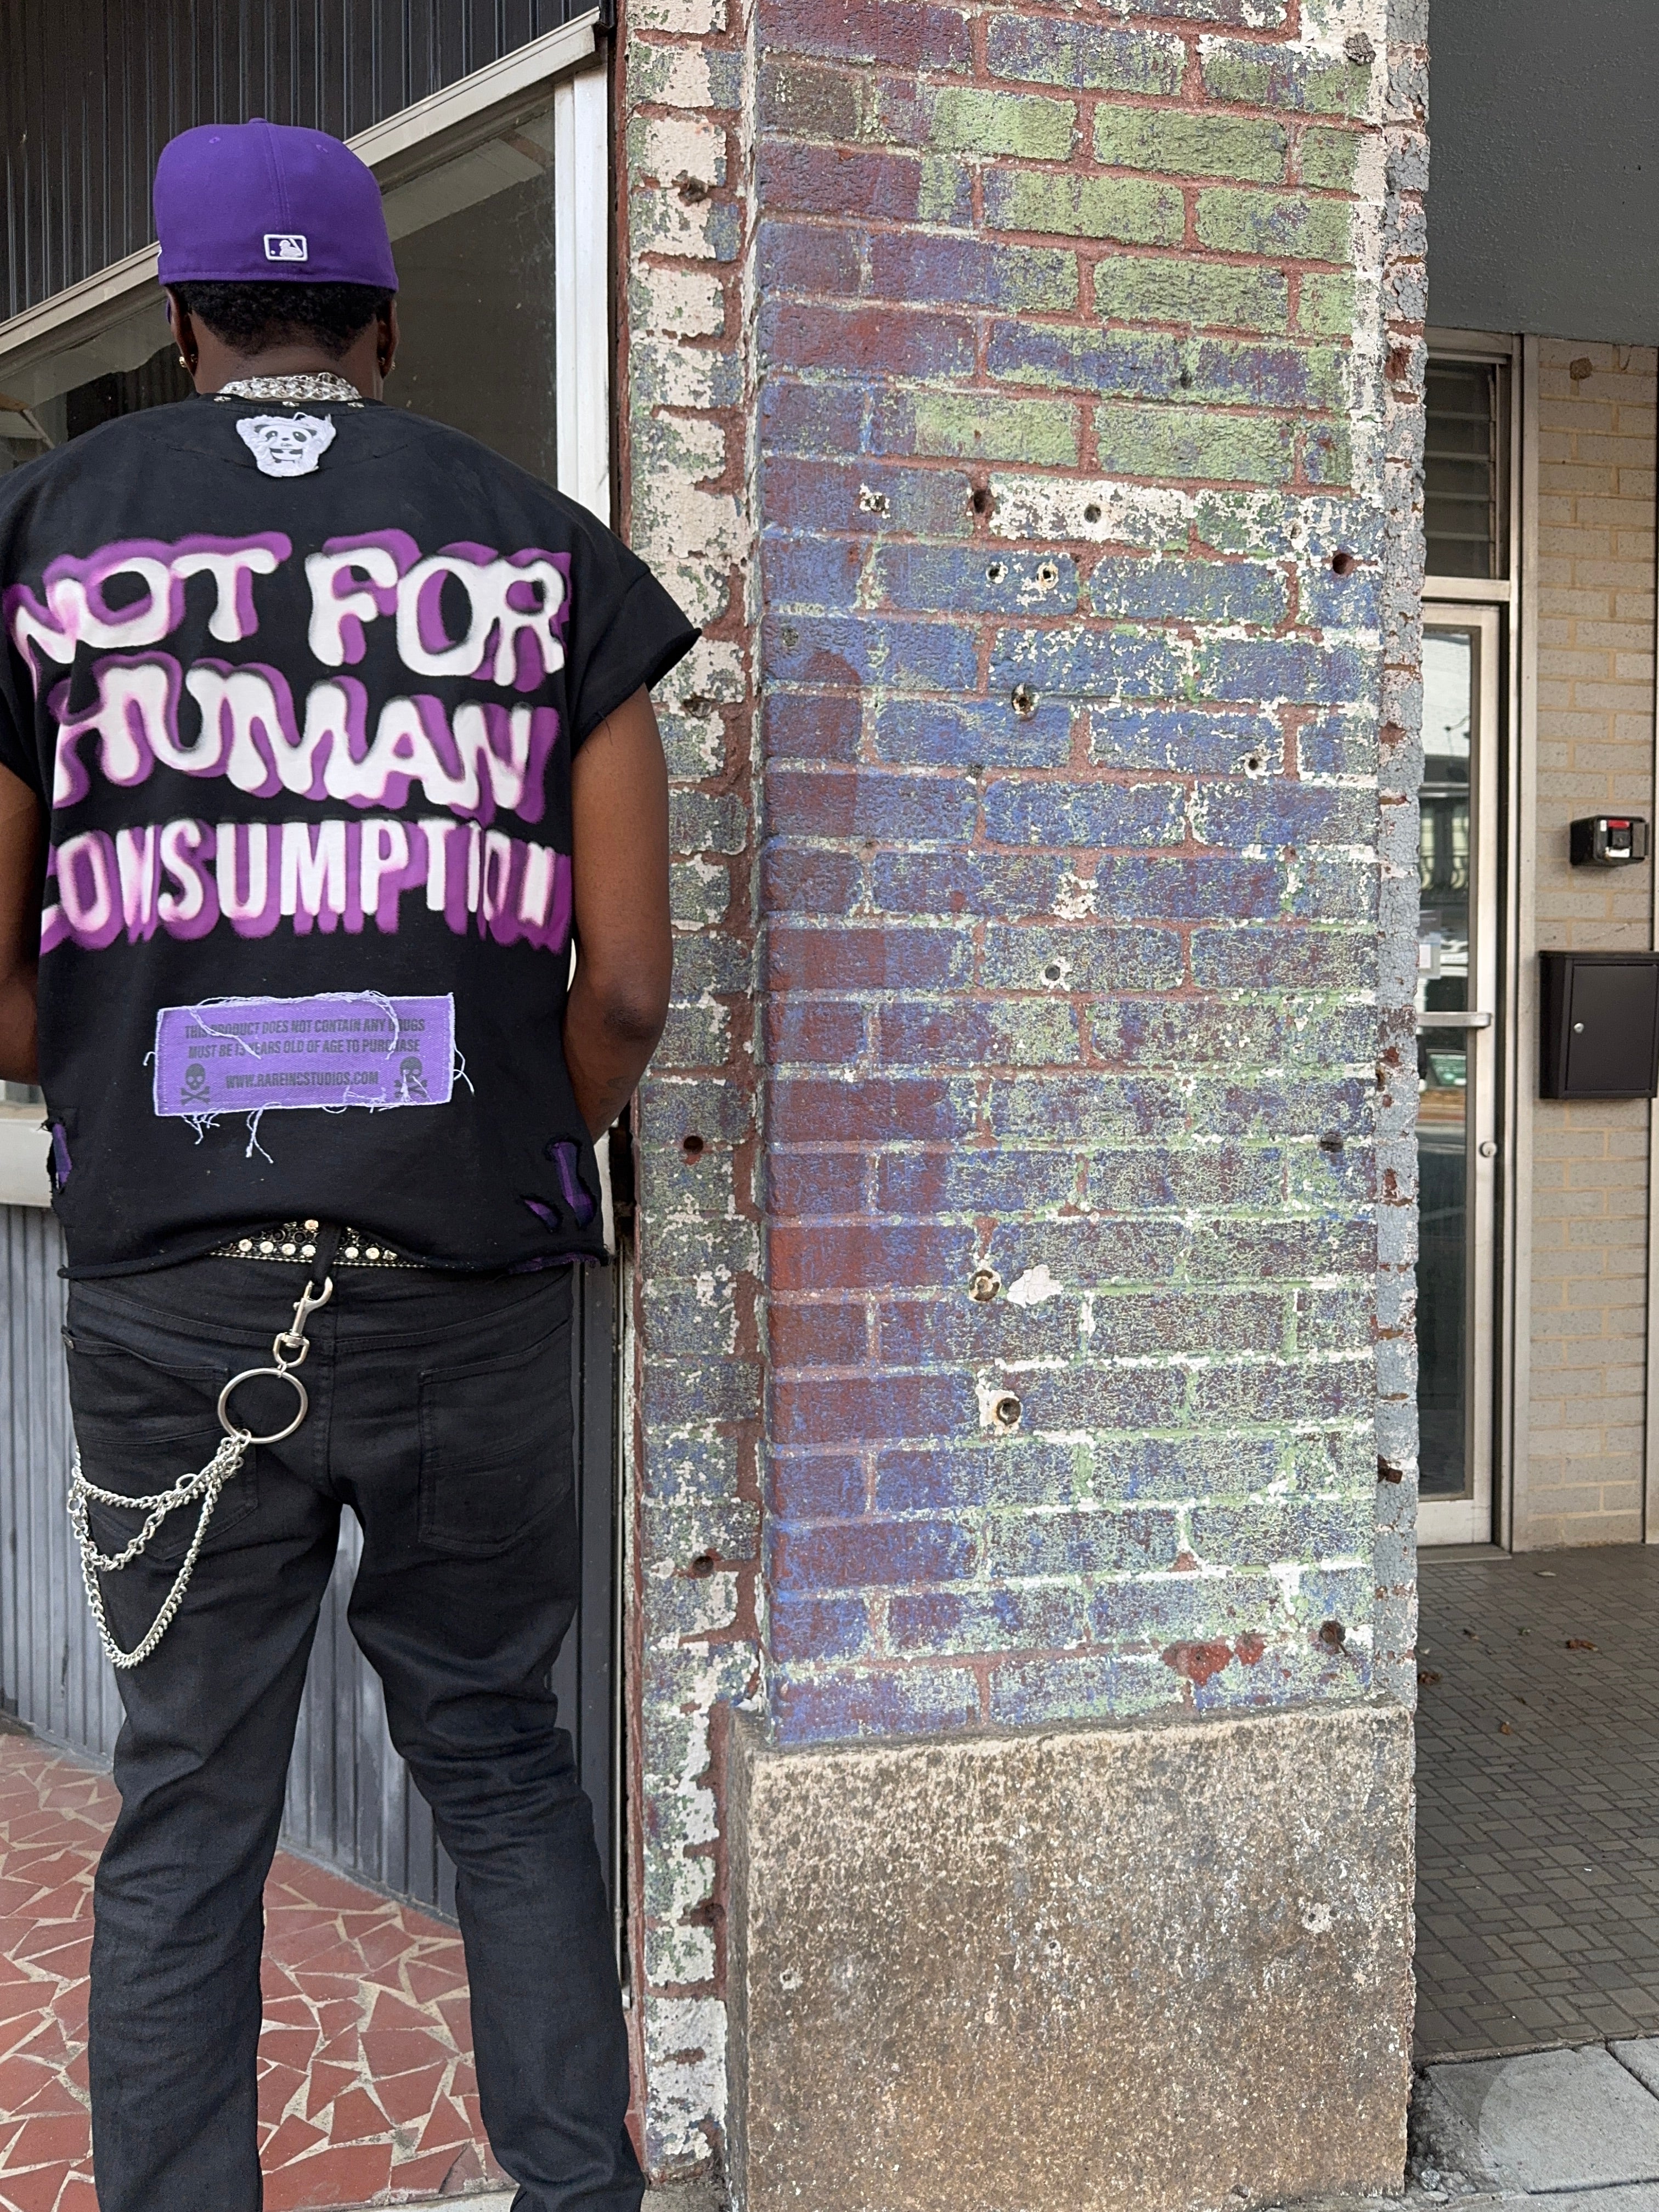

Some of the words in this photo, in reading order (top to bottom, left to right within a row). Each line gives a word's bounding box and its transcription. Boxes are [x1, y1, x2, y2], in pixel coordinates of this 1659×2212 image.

[5, 533, 290, 699] NOT
[305, 531, 571, 690] FOR
[52, 655, 551, 817] HUMAN
[42, 819, 569, 952] ONSUMPTION
[185, 1025, 207, 1039] THIS
[211, 1022, 260, 1037] PRODUCT
[263, 1020, 289, 1034] DOES
[292, 1019, 312, 1033] NOT
[315, 1019, 360, 1032] CONTAIN
[364, 1018, 385, 1031] ANY
[189, 1045, 217, 1059] MUST
[219, 1044, 233, 1057] BE
[284, 1040, 304, 1053] OLD
[307, 1040, 320, 1053] OF
[323, 1039, 343, 1053] AGE
[347, 1039, 359, 1052] TO
